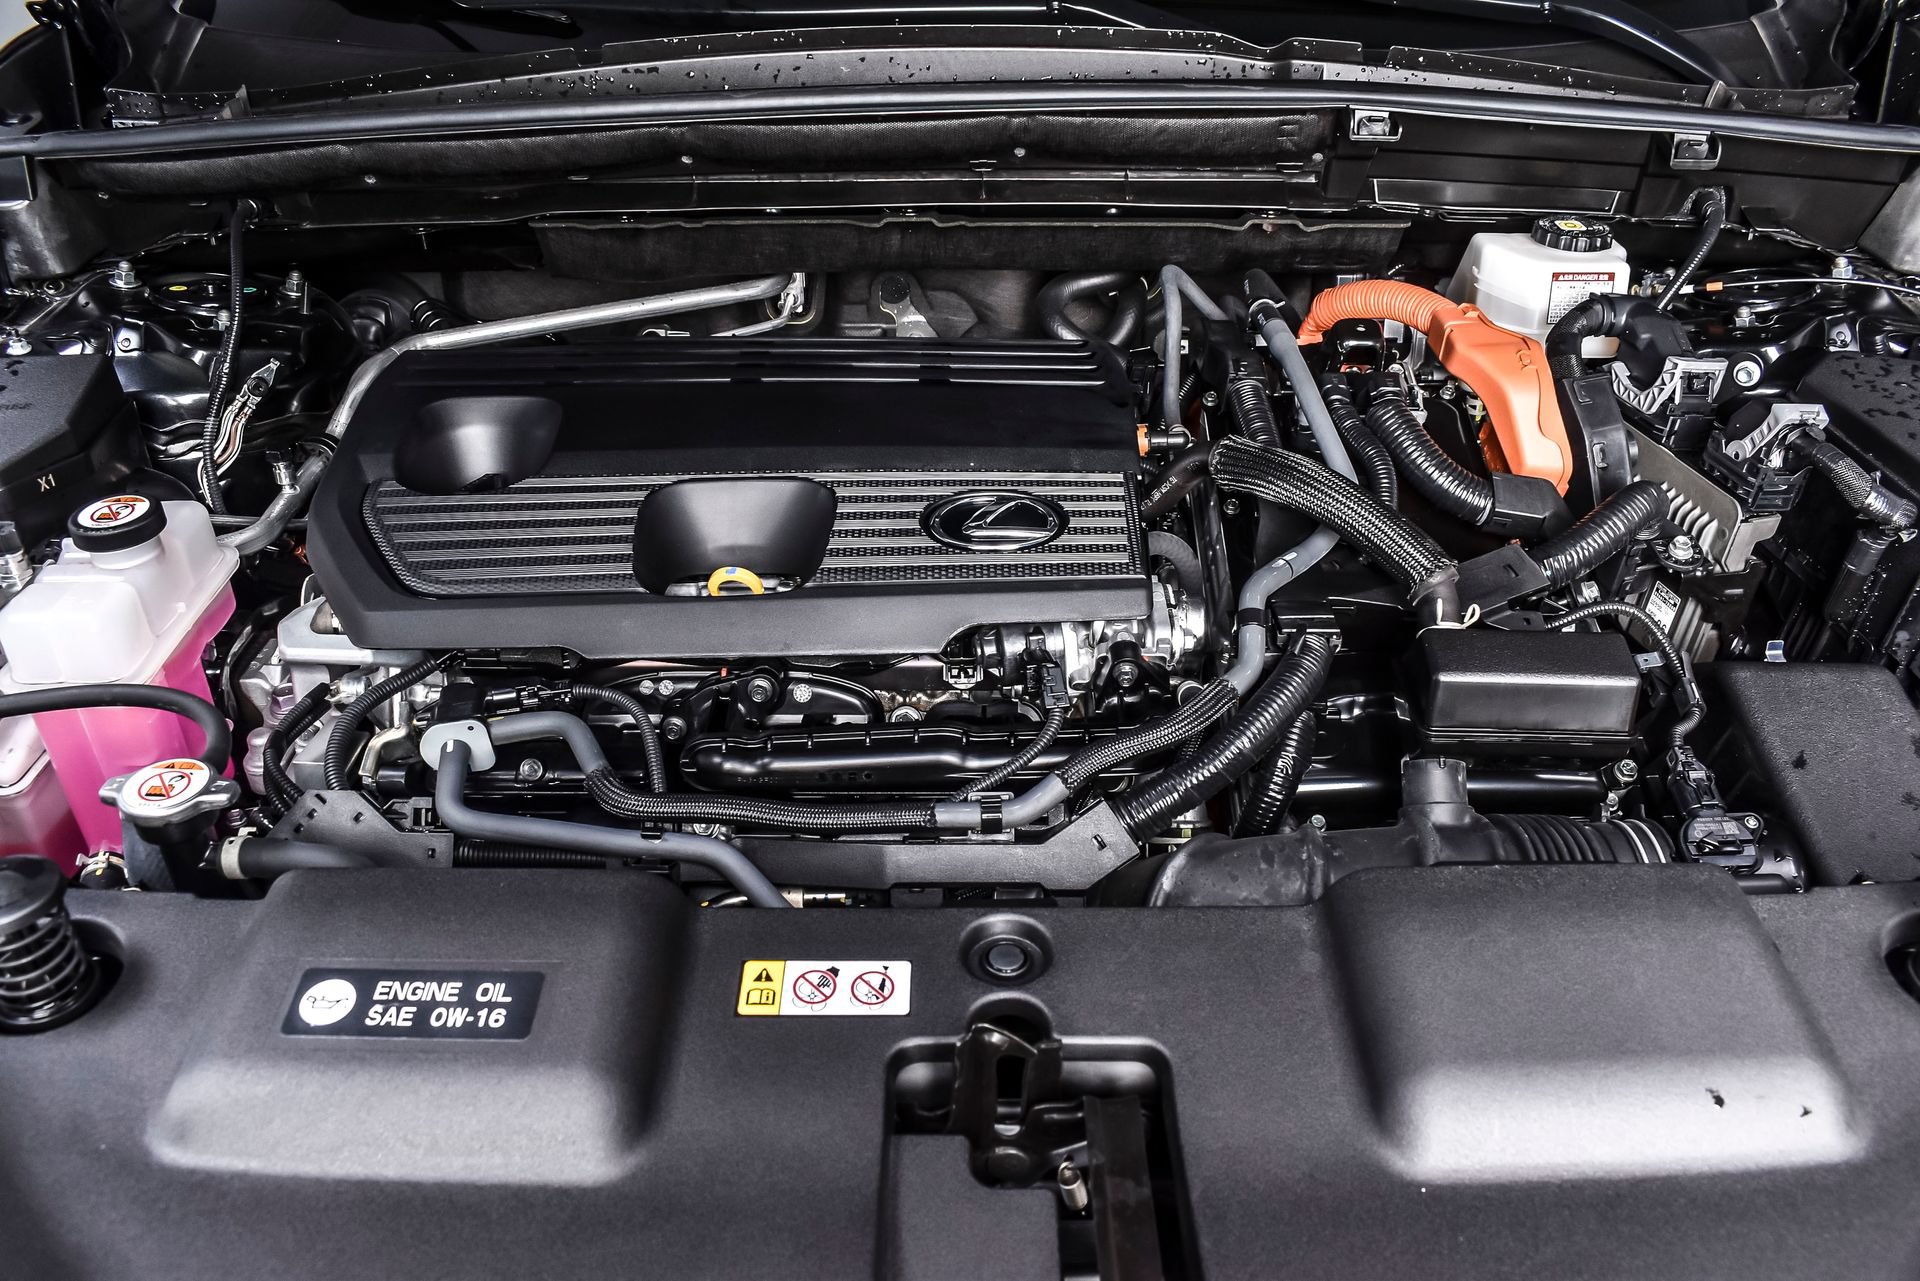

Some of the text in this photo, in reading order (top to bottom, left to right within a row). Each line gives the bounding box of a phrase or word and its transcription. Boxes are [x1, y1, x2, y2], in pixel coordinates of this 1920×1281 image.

[37, 473, 56, 492] X1
[372, 981, 513, 1003] ENGINE OIL
[364, 1005, 508, 1028] SAE 0W-16
